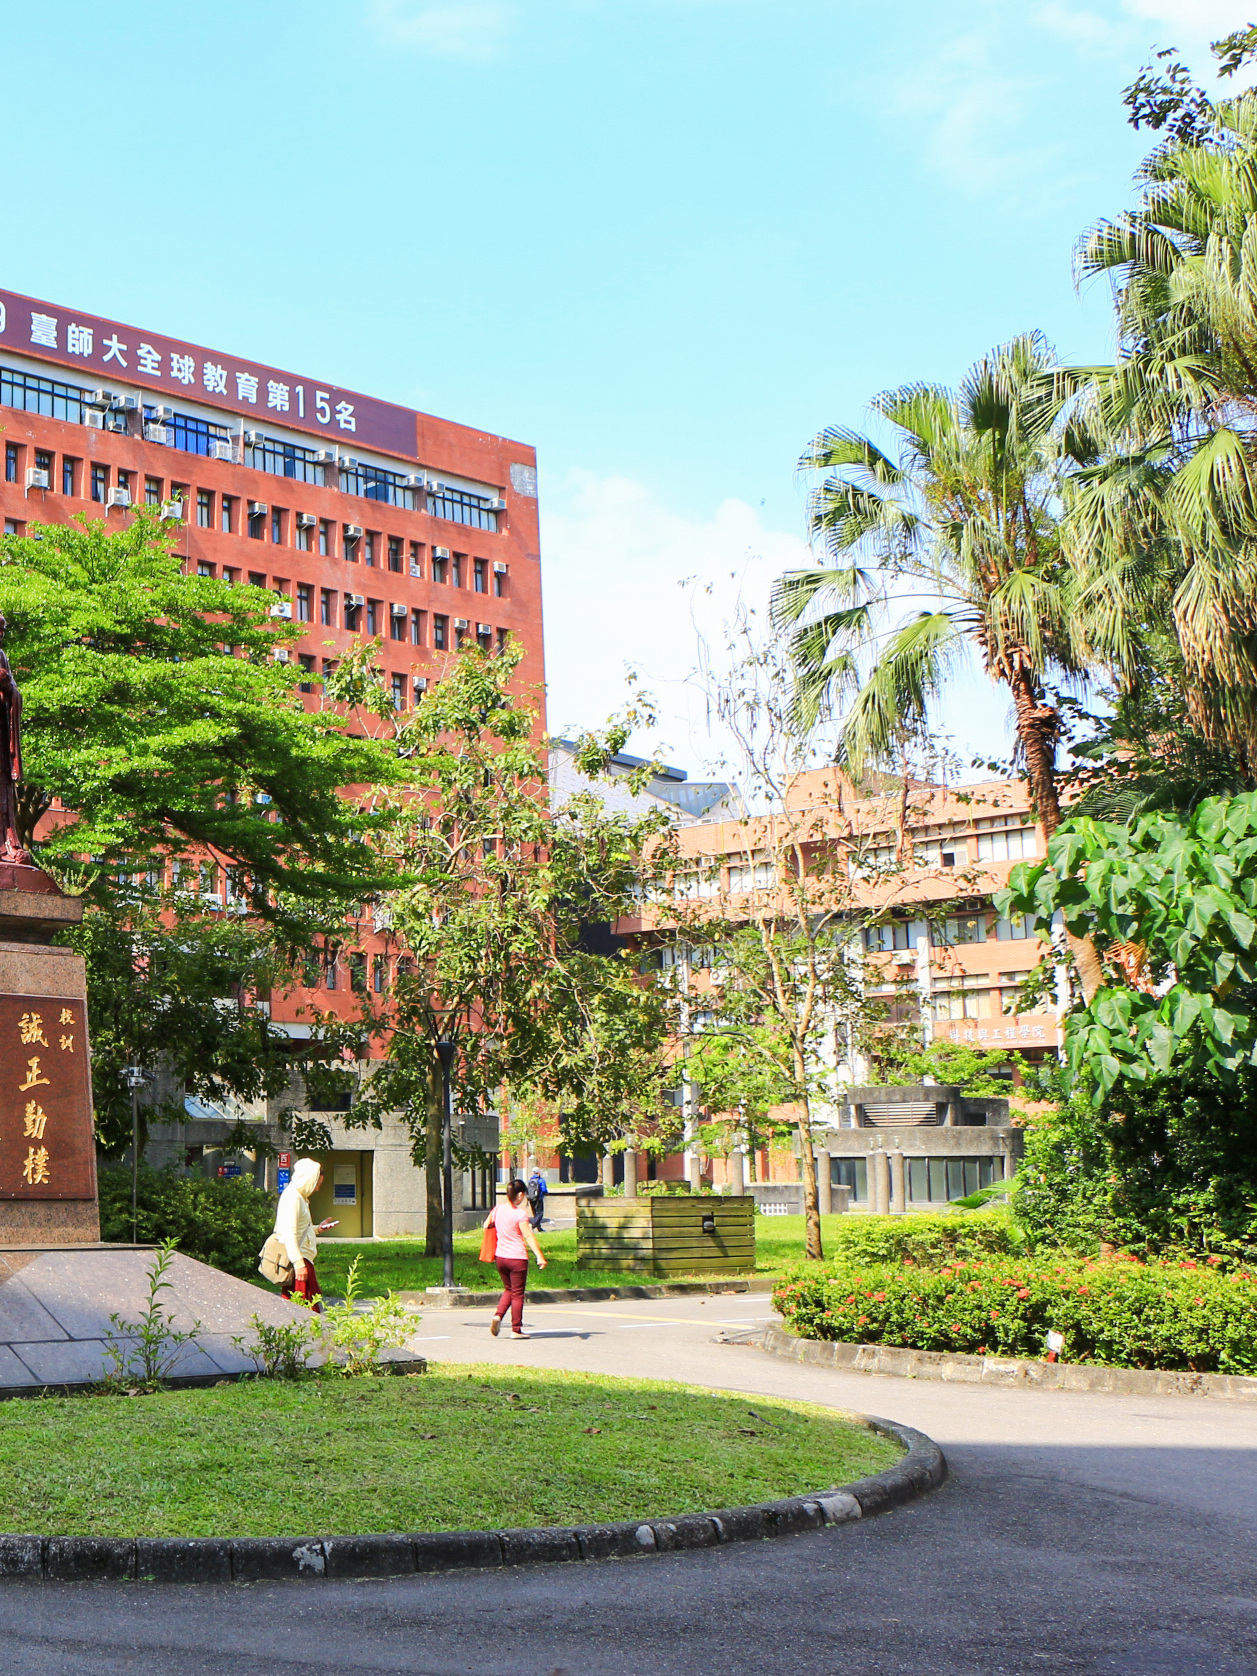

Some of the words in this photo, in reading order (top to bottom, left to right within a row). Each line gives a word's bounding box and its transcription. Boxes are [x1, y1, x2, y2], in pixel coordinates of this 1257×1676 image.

[58, 1007, 76, 1053] 校訓
[18, 1012, 51, 1185] 誠正勤樸
